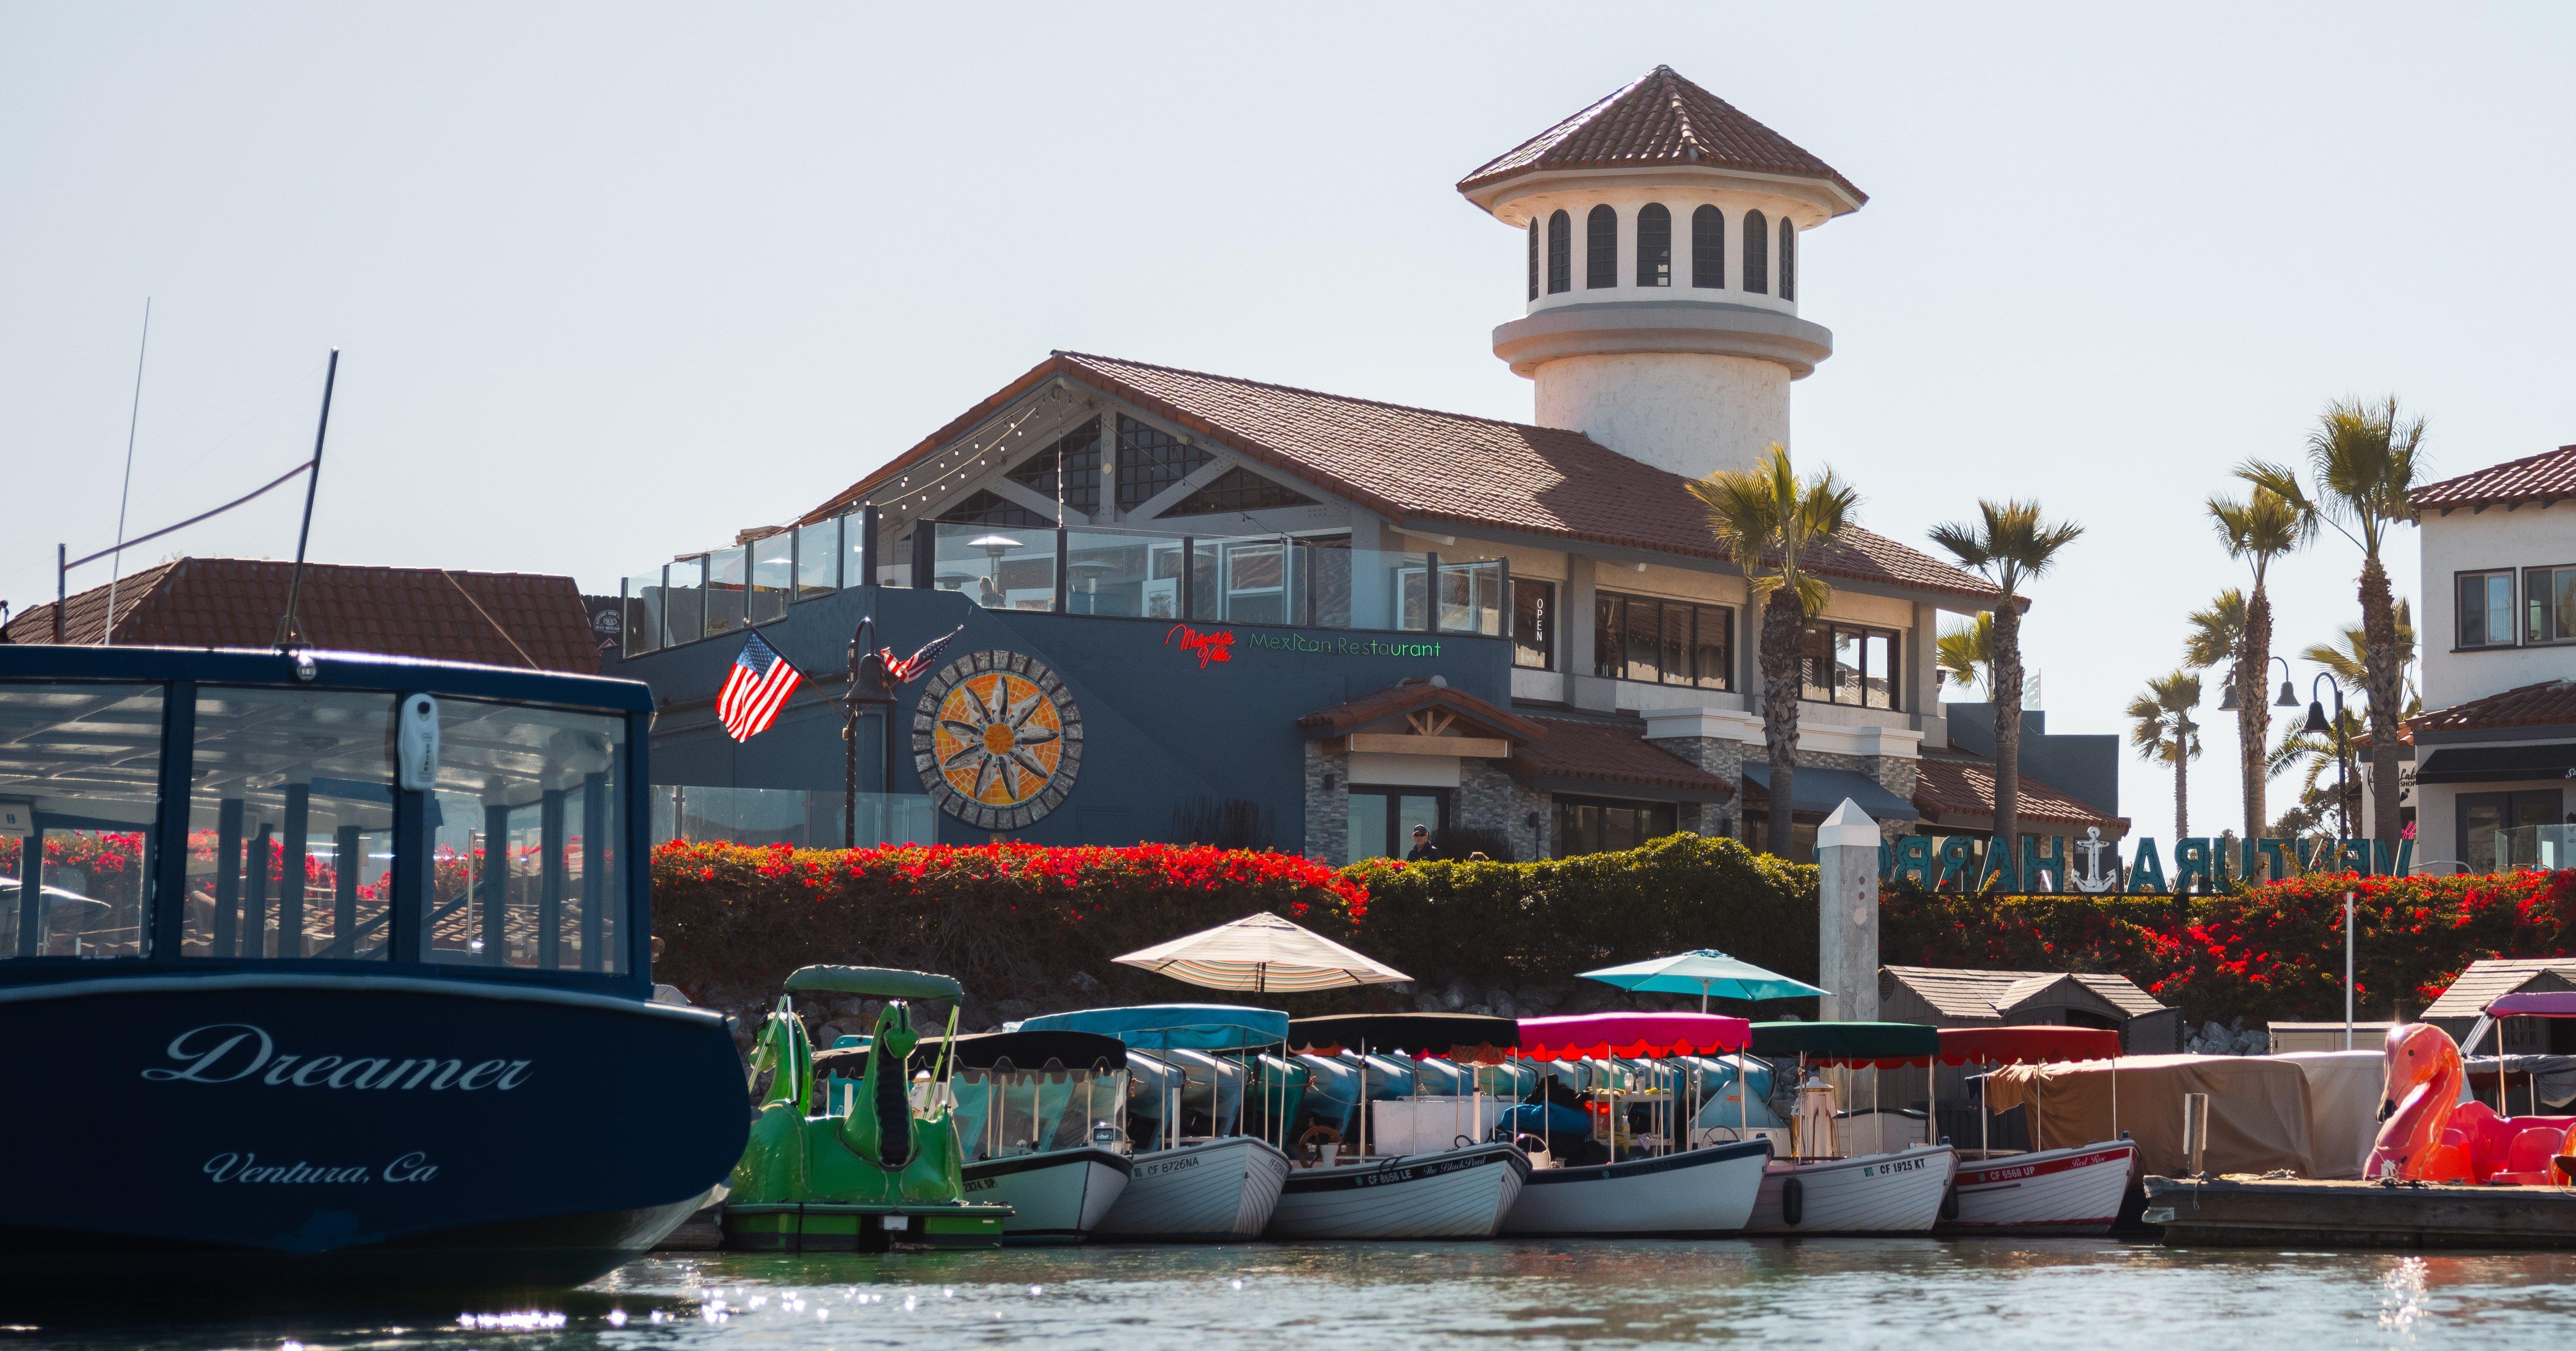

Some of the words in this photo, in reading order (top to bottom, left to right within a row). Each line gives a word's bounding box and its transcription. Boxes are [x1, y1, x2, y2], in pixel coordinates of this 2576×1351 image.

[1249, 633, 1331, 653] Mexican
[1339, 637, 1441, 657] Restaurant
[2399, 768, 2415, 781] Lab
[141, 1023, 533, 1091] Dreamer
[202, 1152, 370, 1185] Ventura,
[382, 1151, 440, 1183] Ca
[1147, 1165, 1159, 1175] CF
[1162, 1157, 1199, 1173] 8726NA
[1423, 1165, 1437, 1176] The
[1440, 1161, 1464, 1173] Black
[1463, 1156, 1486, 1169] Pearl
[1879, 1165, 1890, 1174] CF
[1892, 1161, 1913, 1173] 1925
[1914, 1159, 1926, 1170] KT
[2071, 1157, 2088, 1169] Red
[2089, 1154, 2106, 1165] Roe
[1368, 1175, 1378, 1184] CF
[1400, 1170, 1412, 1180] LE
[1990, 1171, 2000, 1181] CF
[2002, 1168, 2022, 1179] 6568
[2023, 1166, 2035, 1176] UP
